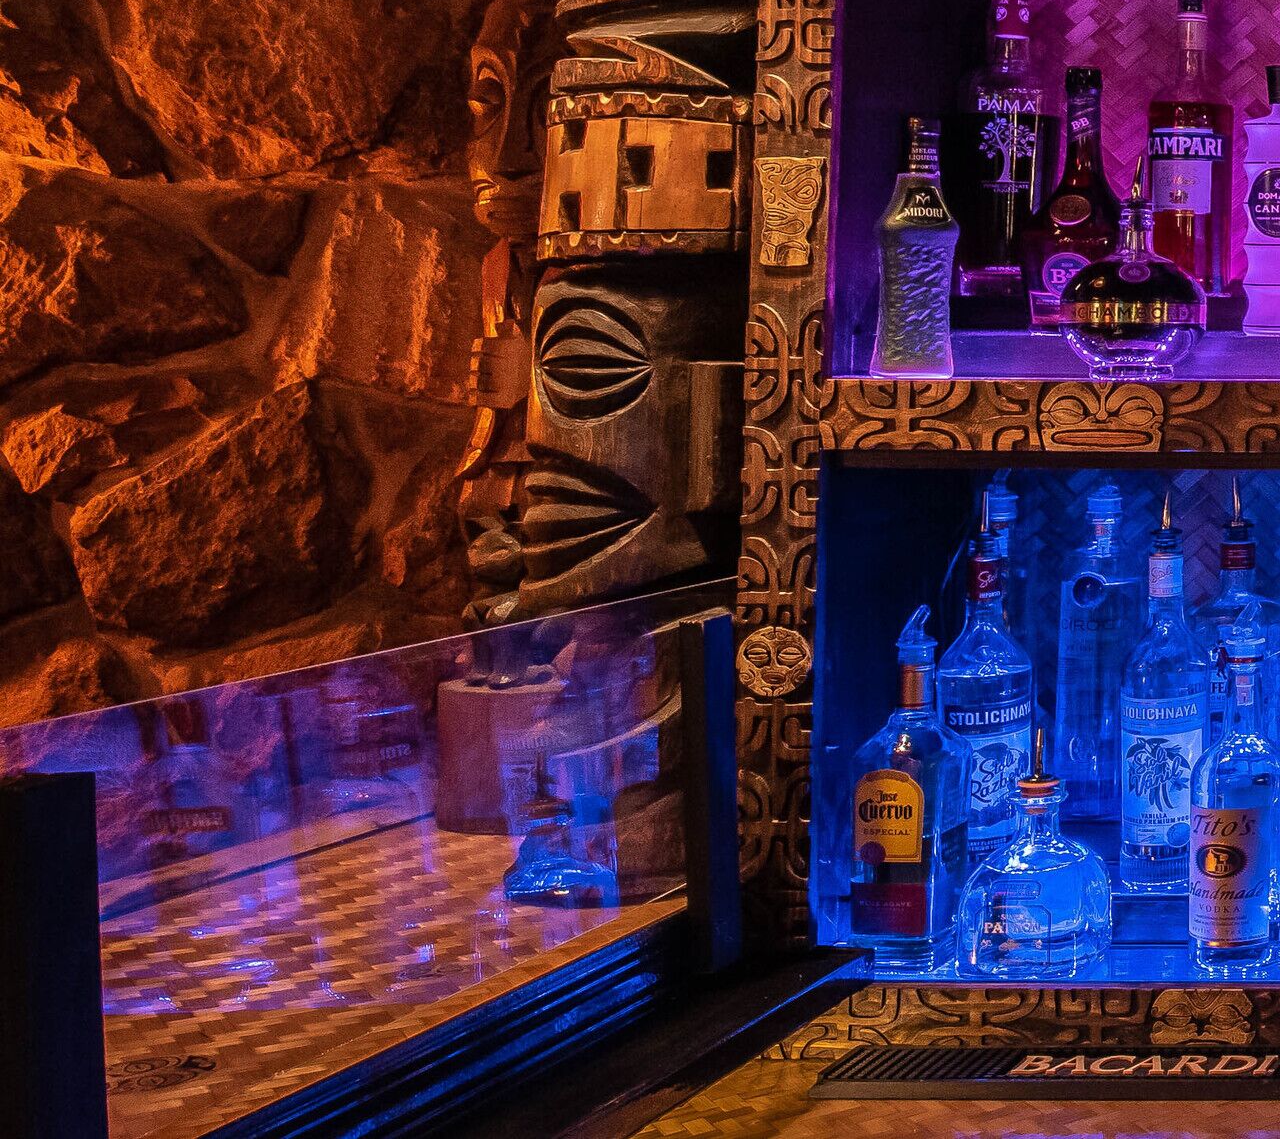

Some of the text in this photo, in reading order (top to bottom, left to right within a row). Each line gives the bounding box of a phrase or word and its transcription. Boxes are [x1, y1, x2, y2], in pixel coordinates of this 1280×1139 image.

[977, 98, 1037, 112] PAMA
[1147, 136, 1223, 157] CAMPARI
[903, 207, 943, 218] MIDORI
[1077, 303, 1188, 320] CHAMBORD
[859, 798, 913, 822] Cuervo
[863, 828, 911, 836] ESPECIAL
[1193, 813, 1257, 837] Tito's
[1198, 904, 1241, 913] VODKA
[1009, 1054, 1280, 1075] BACARDI
